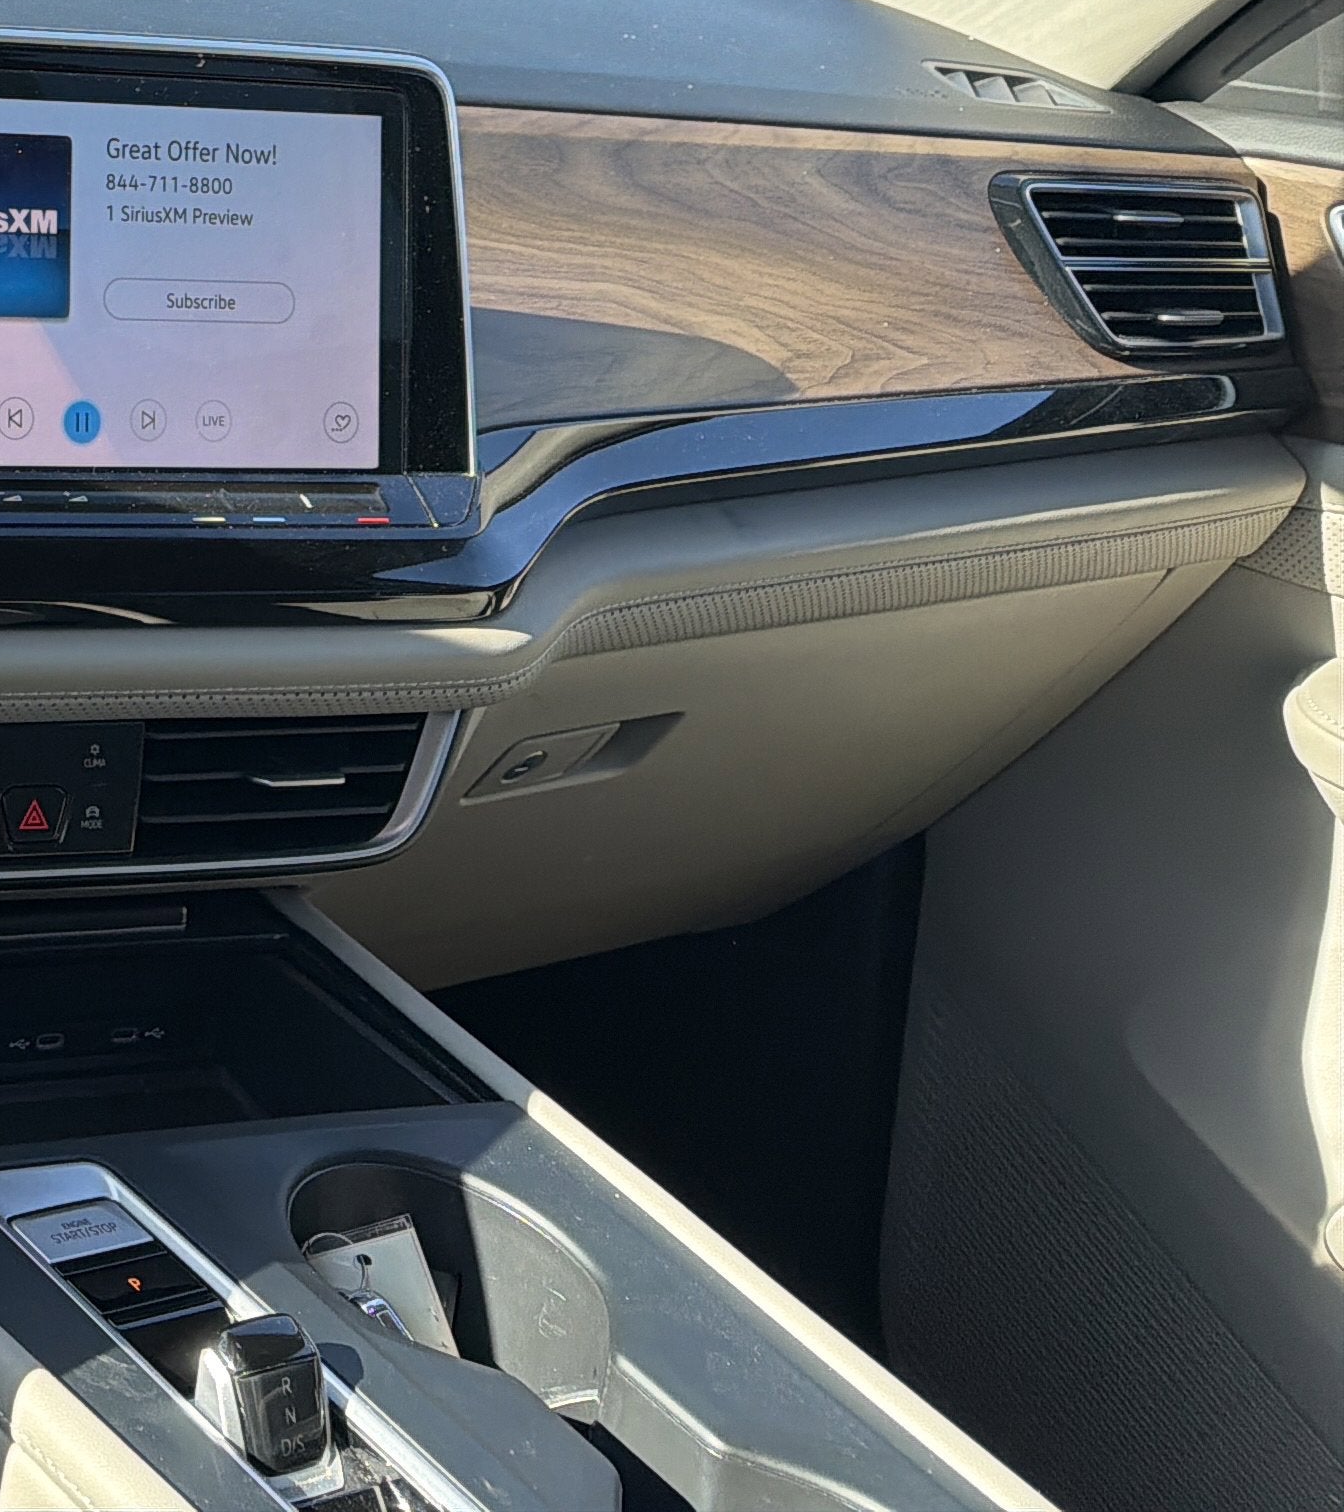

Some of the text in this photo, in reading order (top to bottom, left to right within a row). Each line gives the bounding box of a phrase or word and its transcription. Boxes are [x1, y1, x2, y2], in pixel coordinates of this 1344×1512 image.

[106, 137, 277, 166] Great Offer Now!
[105, 173, 233, 195] 844-711-8800
[106, 205, 254, 226] 1 SiriusXM Preview
[166, 292, 236, 310] Subscribe
[202, 415, 225, 427] LIVE
[83, 758, 106, 768] CLIMA
[80, 819, 104, 829] MODE
[50, 1222, 117, 1245] START/STOP
[127, 1277, 142, 1292] P
[281, 1376, 293, 1396] R
[284, 1406, 297, 1425] N
[281, 1433, 306, 1457] D/S
